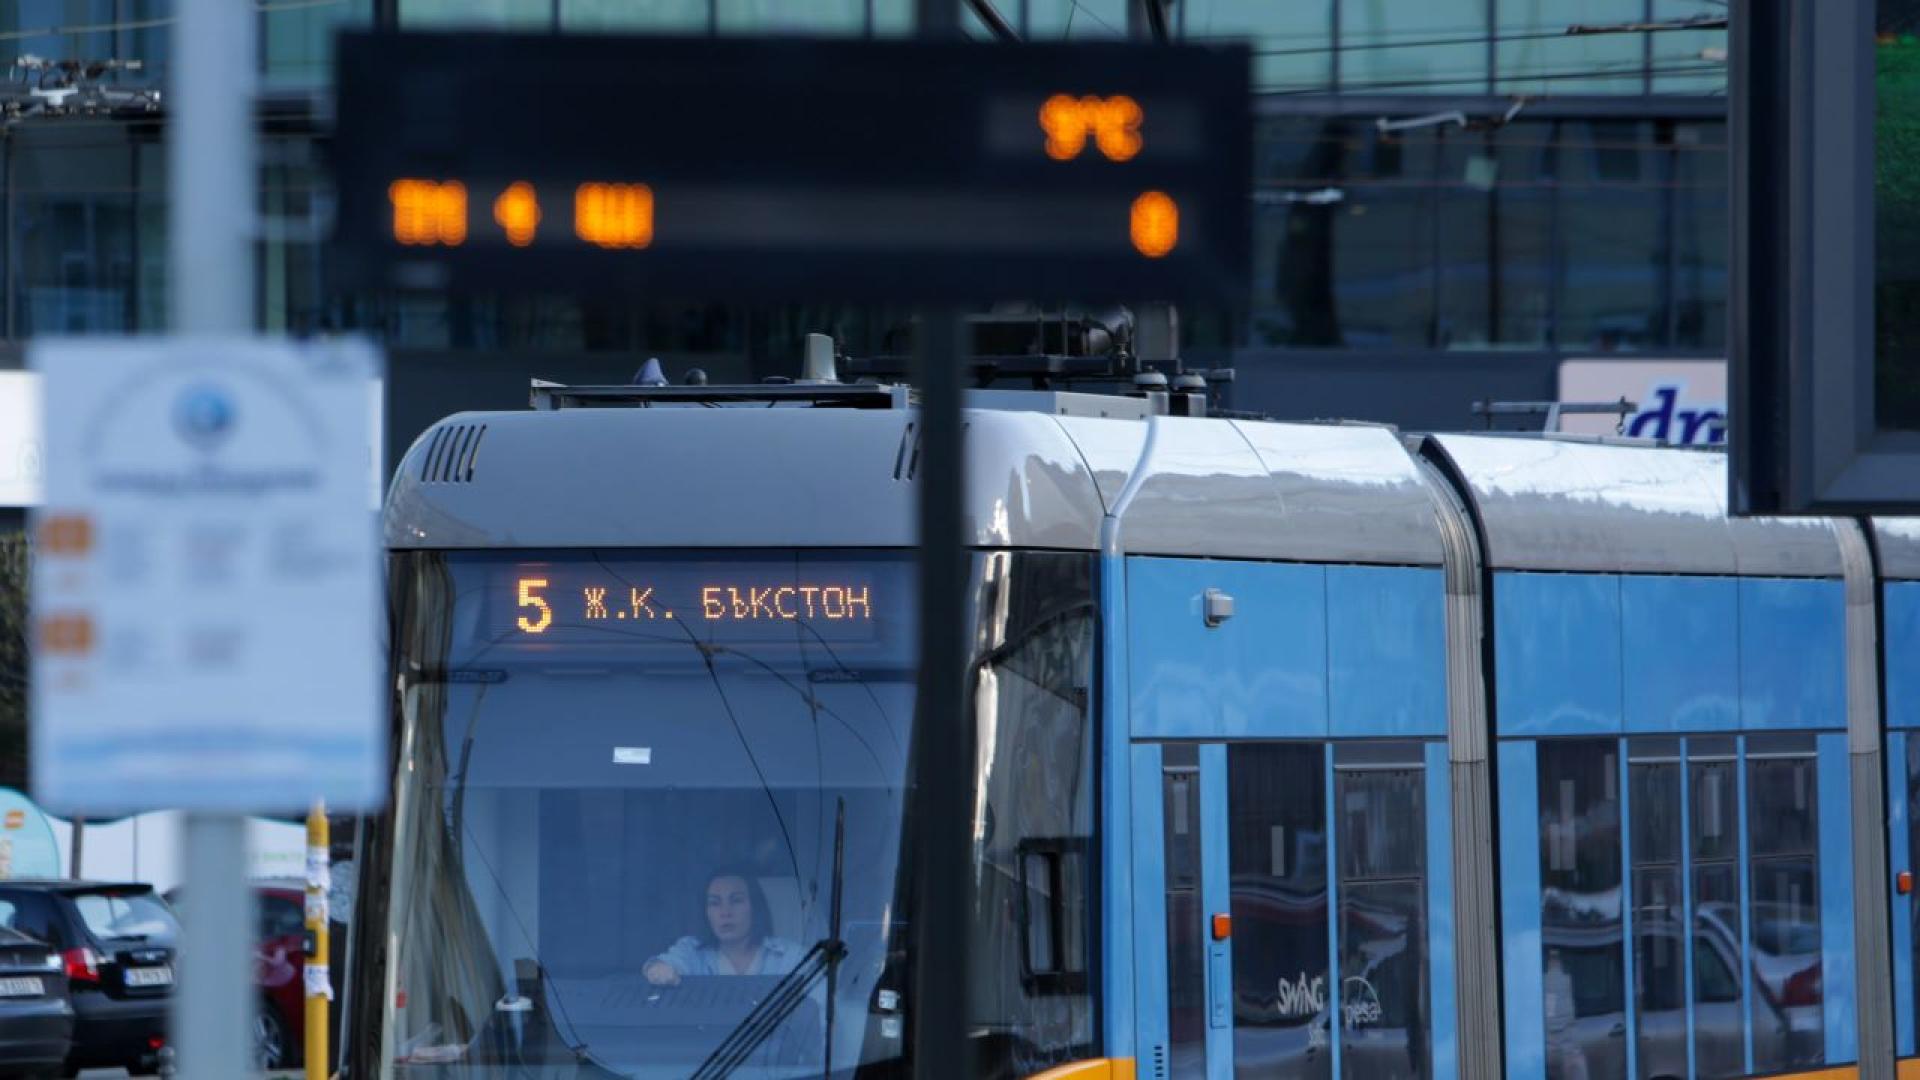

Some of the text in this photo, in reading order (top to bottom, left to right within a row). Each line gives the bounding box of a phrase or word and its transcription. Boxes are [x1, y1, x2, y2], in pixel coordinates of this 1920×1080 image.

[517, 578, 871, 633] 5 Ж.К. БЪКСТОН
